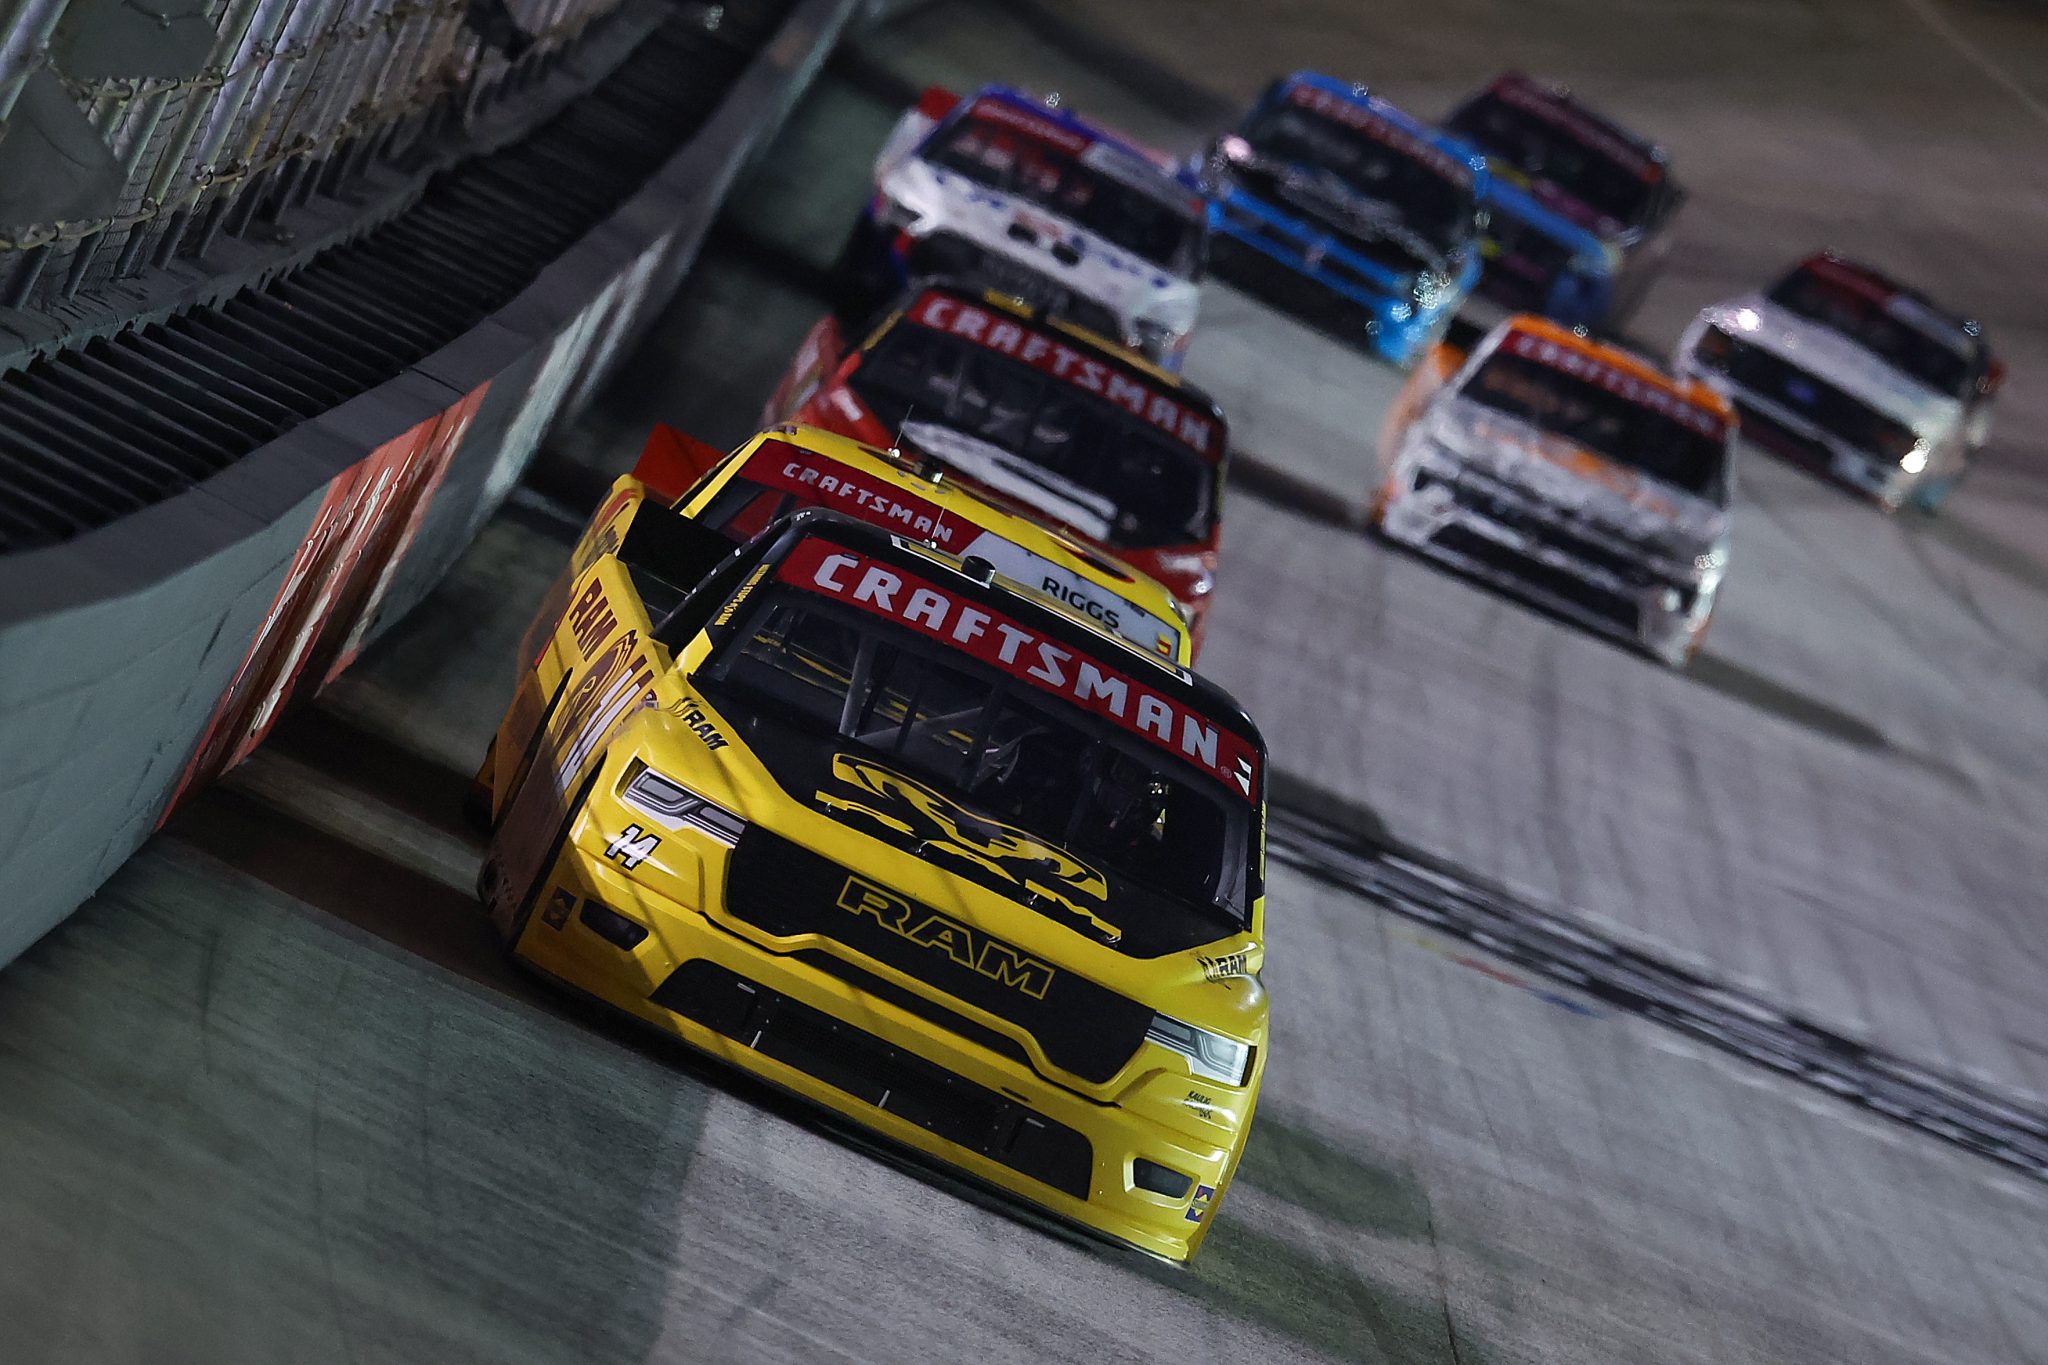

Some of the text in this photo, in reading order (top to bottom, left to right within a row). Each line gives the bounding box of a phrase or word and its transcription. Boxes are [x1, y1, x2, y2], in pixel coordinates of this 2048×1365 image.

[921, 298, 1210, 450] CRAFTSMAN
[782, 462, 953, 543] CRAFTSMAN
[569, 577, 618, 662] RAM
[1041, 576, 1120, 629] RIGGS
[813, 554, 1219, 769] CRAFTSMAN
[684, 708, 729, 751] RAM
[603, 823, 662, 871] 14
[836, 875, 1055, 1001] RAM
